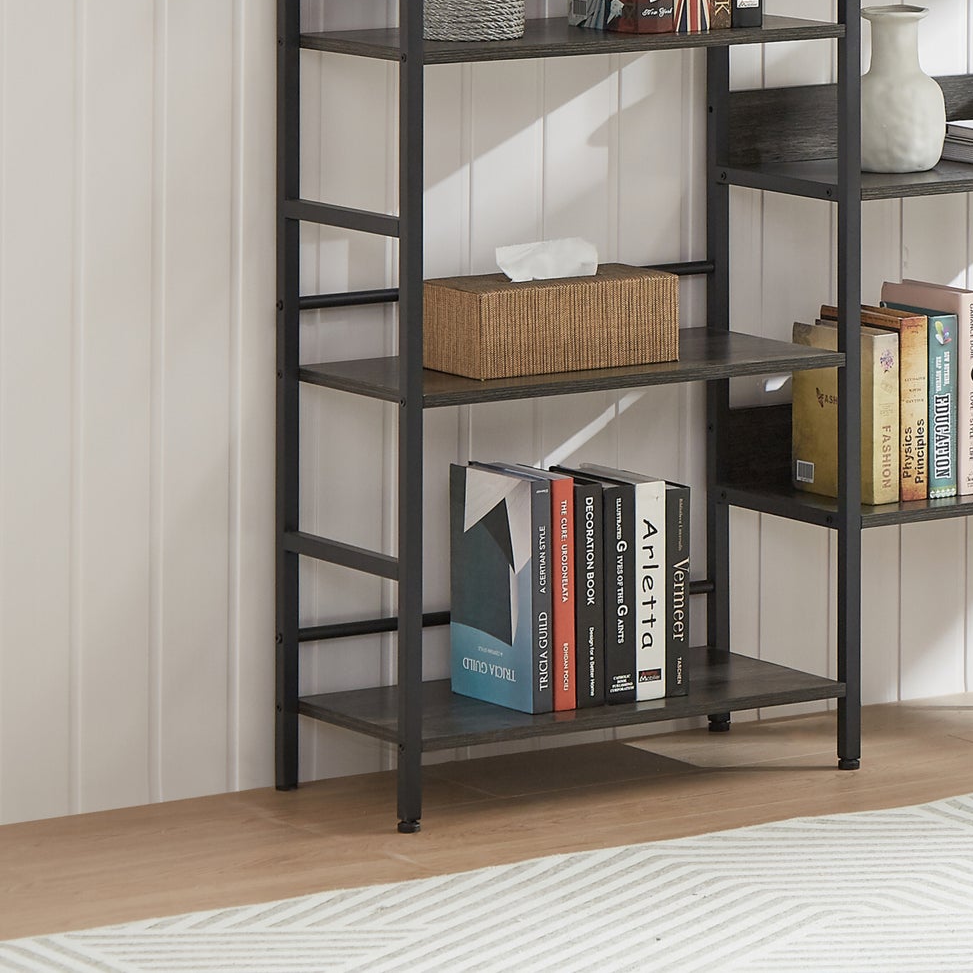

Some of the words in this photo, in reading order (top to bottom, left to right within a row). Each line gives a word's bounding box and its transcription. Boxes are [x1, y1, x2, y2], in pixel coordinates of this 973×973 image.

[881, 425, 892, 489] FASHION
[902, 426, 914, 479] Physics
[914, 418, 926, 484] Principles
[934, 393, 952, 479] EDUCATION
[538, 525, 547, 551] STYLE
[586, 496, 595, 570] DECORATION
[586, 572, 595, 606] BOOK
[641, 518, 660, 650] Arletta
[673, 556, 690, 642] Vermeer
[538, 611, 548, 649] GUILD
[462, 657, 488, 675] GUILD
[488, 663, 517, 683] TRICIA
[539, 650, 549, 692] TRICIA
